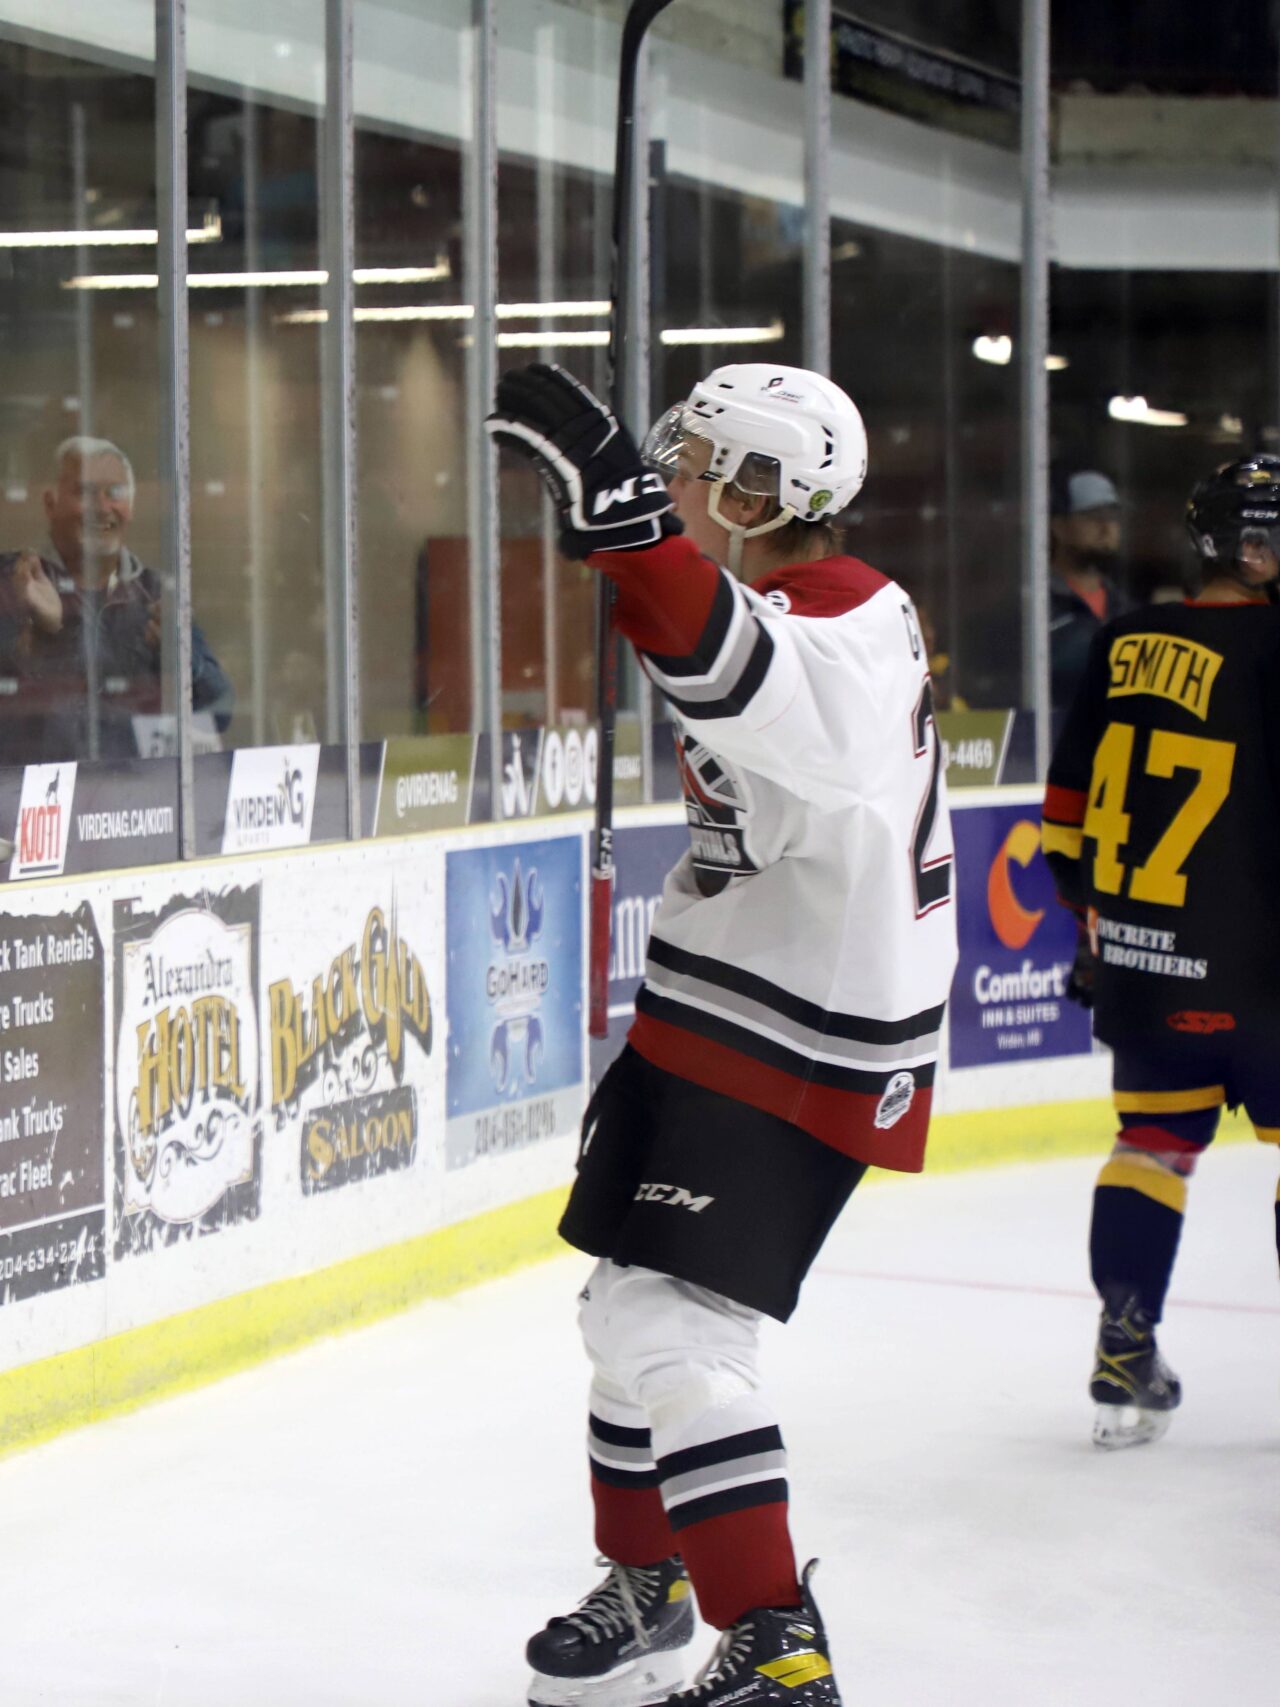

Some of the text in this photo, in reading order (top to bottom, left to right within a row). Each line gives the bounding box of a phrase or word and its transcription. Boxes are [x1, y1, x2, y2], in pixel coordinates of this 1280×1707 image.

[1242, 509, 1279, 519] CCM
[1113, 639, 1208, 708] SMITH
[396, 771, 458, 818] @VIRDENAG
[77, 807, 174, 841] VIRDENAG.CA/KIOTI
[1084, 722, 1236, 906] 47
[20, 805, 61, 863] KIOTI
[13, 936, 44, 969] Tank
[47, 930, 94, 966] Rentals
[1096, 917, 1176, 952] ONCRETE
[143, 949, 234, 1006] Alexandra
[1104, 944, 1208, 980] BROTHERS
[975, 960, 1064, 1004] Comfort
[13, 992, 54, 1027] Trucks
[269, 942, 362, 1106] BLACK
[983, 1009, 1004, 1028] INN
[1016, 1002, 1059, 1025] SUITES
[4, 1048, 39, 1083] Sales
[136, 994, 247, 1137] HOTEL
[22, 1101, 64, 1137] Trucks
[307, 1109, 413, 1181] SALOON
[20, 1158, 53, 1193] Fleet
[634, 1183, 715, 1213] CCM
